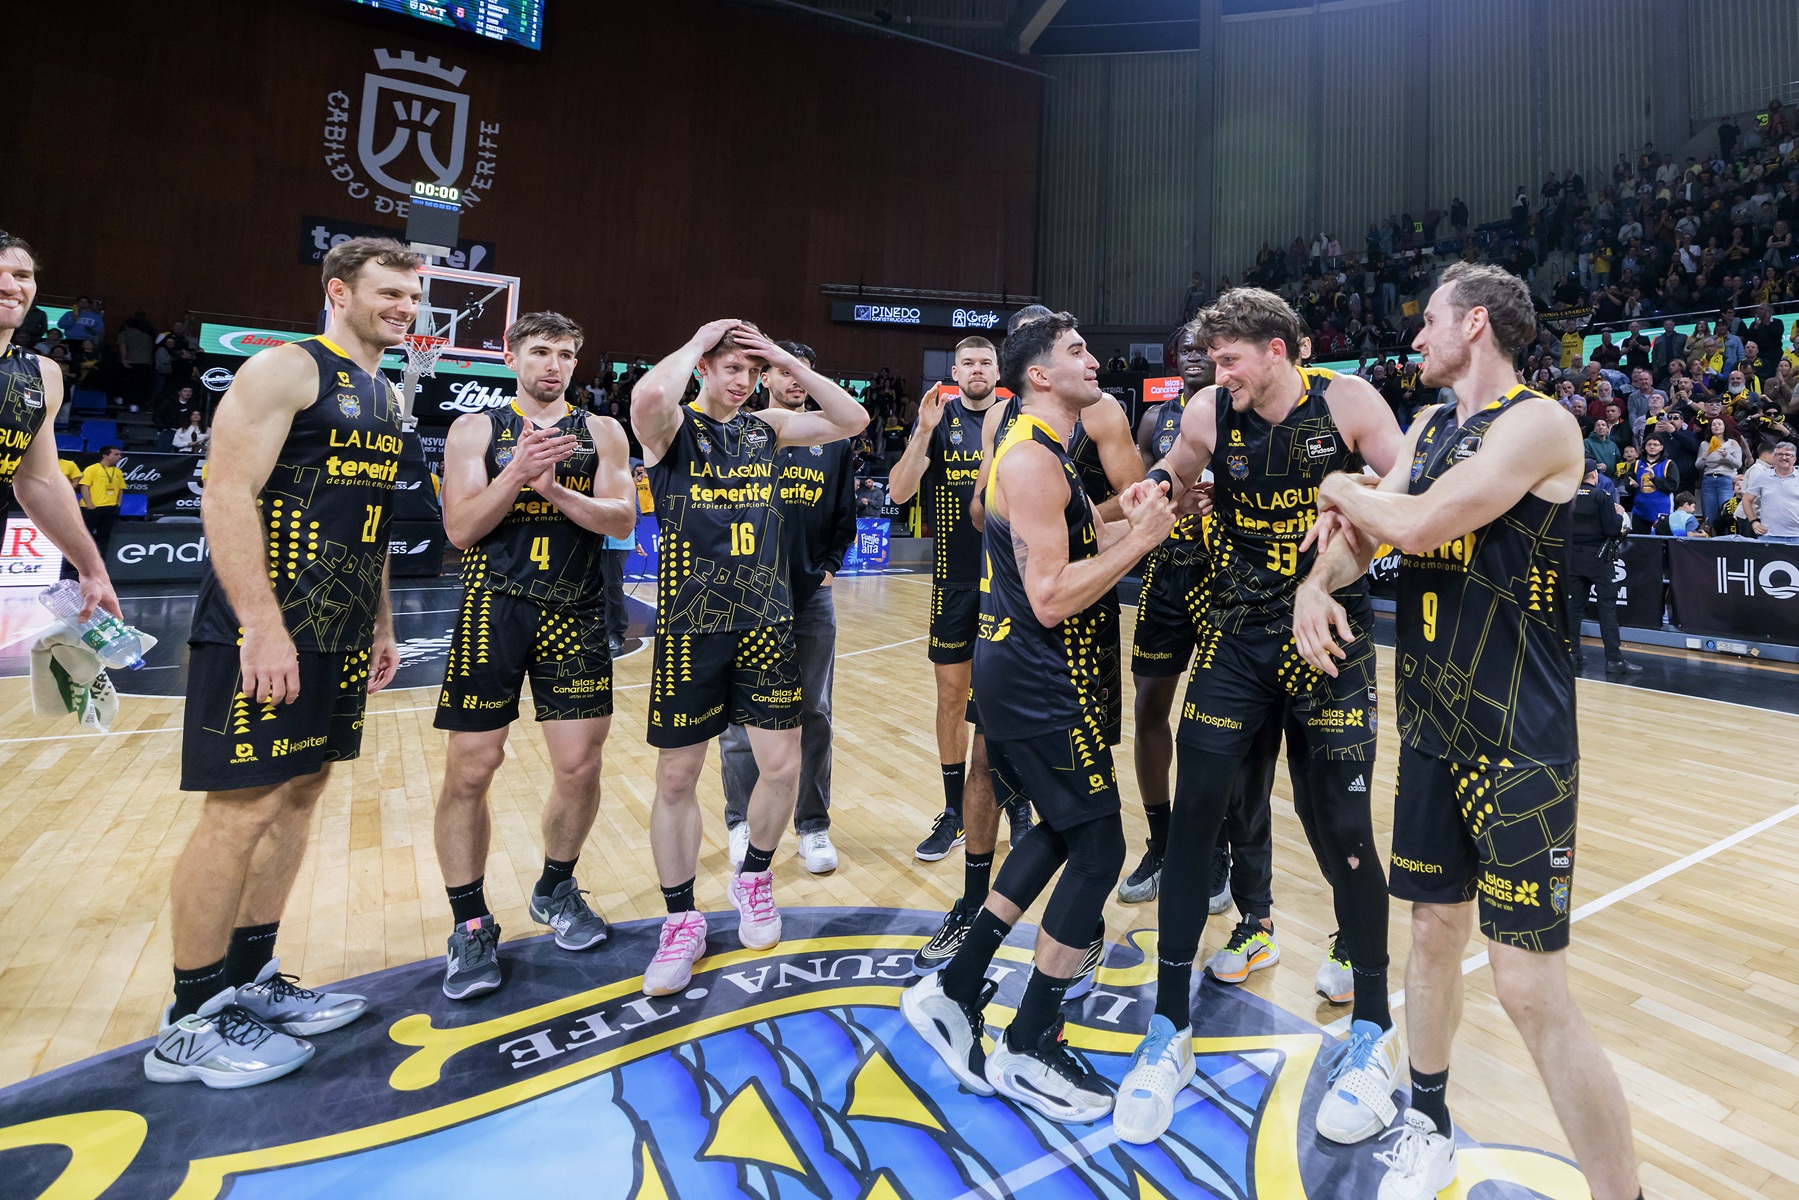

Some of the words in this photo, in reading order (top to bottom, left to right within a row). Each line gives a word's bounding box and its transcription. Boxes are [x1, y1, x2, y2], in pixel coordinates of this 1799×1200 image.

[324, 90, 369, 199] CABILDO
[373, 195, 409, 218] DE
[460, 120, 500, 214] NERIFE
[415, 181, 459, 200] 00:00
[424, 201, 459, 212] MONDO
[872, 306, 921, 319] PINEDO
[966, 310, 999, 329] Coraje
[329, 429, 362, 448] LA
[943, 450, 960, 462] LA
[690, 461, 713, 478] LA
[361, 504, 383, 543] 21
[730, 522, 755, 556] 16
[117, 536, 209, 564] end
[529, 536, 550, 571] 4
[1265, 540, 1297, 577] 33
[1422, 592, 1438, 643] 9
[1140, 650, 1172, 660] Hospiten
[552, 685, 595, 694] Canarias
[572, 678, 595, 688] Islas
[771, 688, 792, 697] Islas
[751, 693, 792, 703] Canarias
[1196, 711, 1242, 730] Hospiten
[1308, 717, 1344, 727] Canarias
[1321, 709, 1344, 718] Islas
[289, 735, 328, 754] Hospiten
[1553, 855, 1569, 865] acb
[1485, 870, 1513, 891] Islas
[498, 996, 681, 1070] TFE
